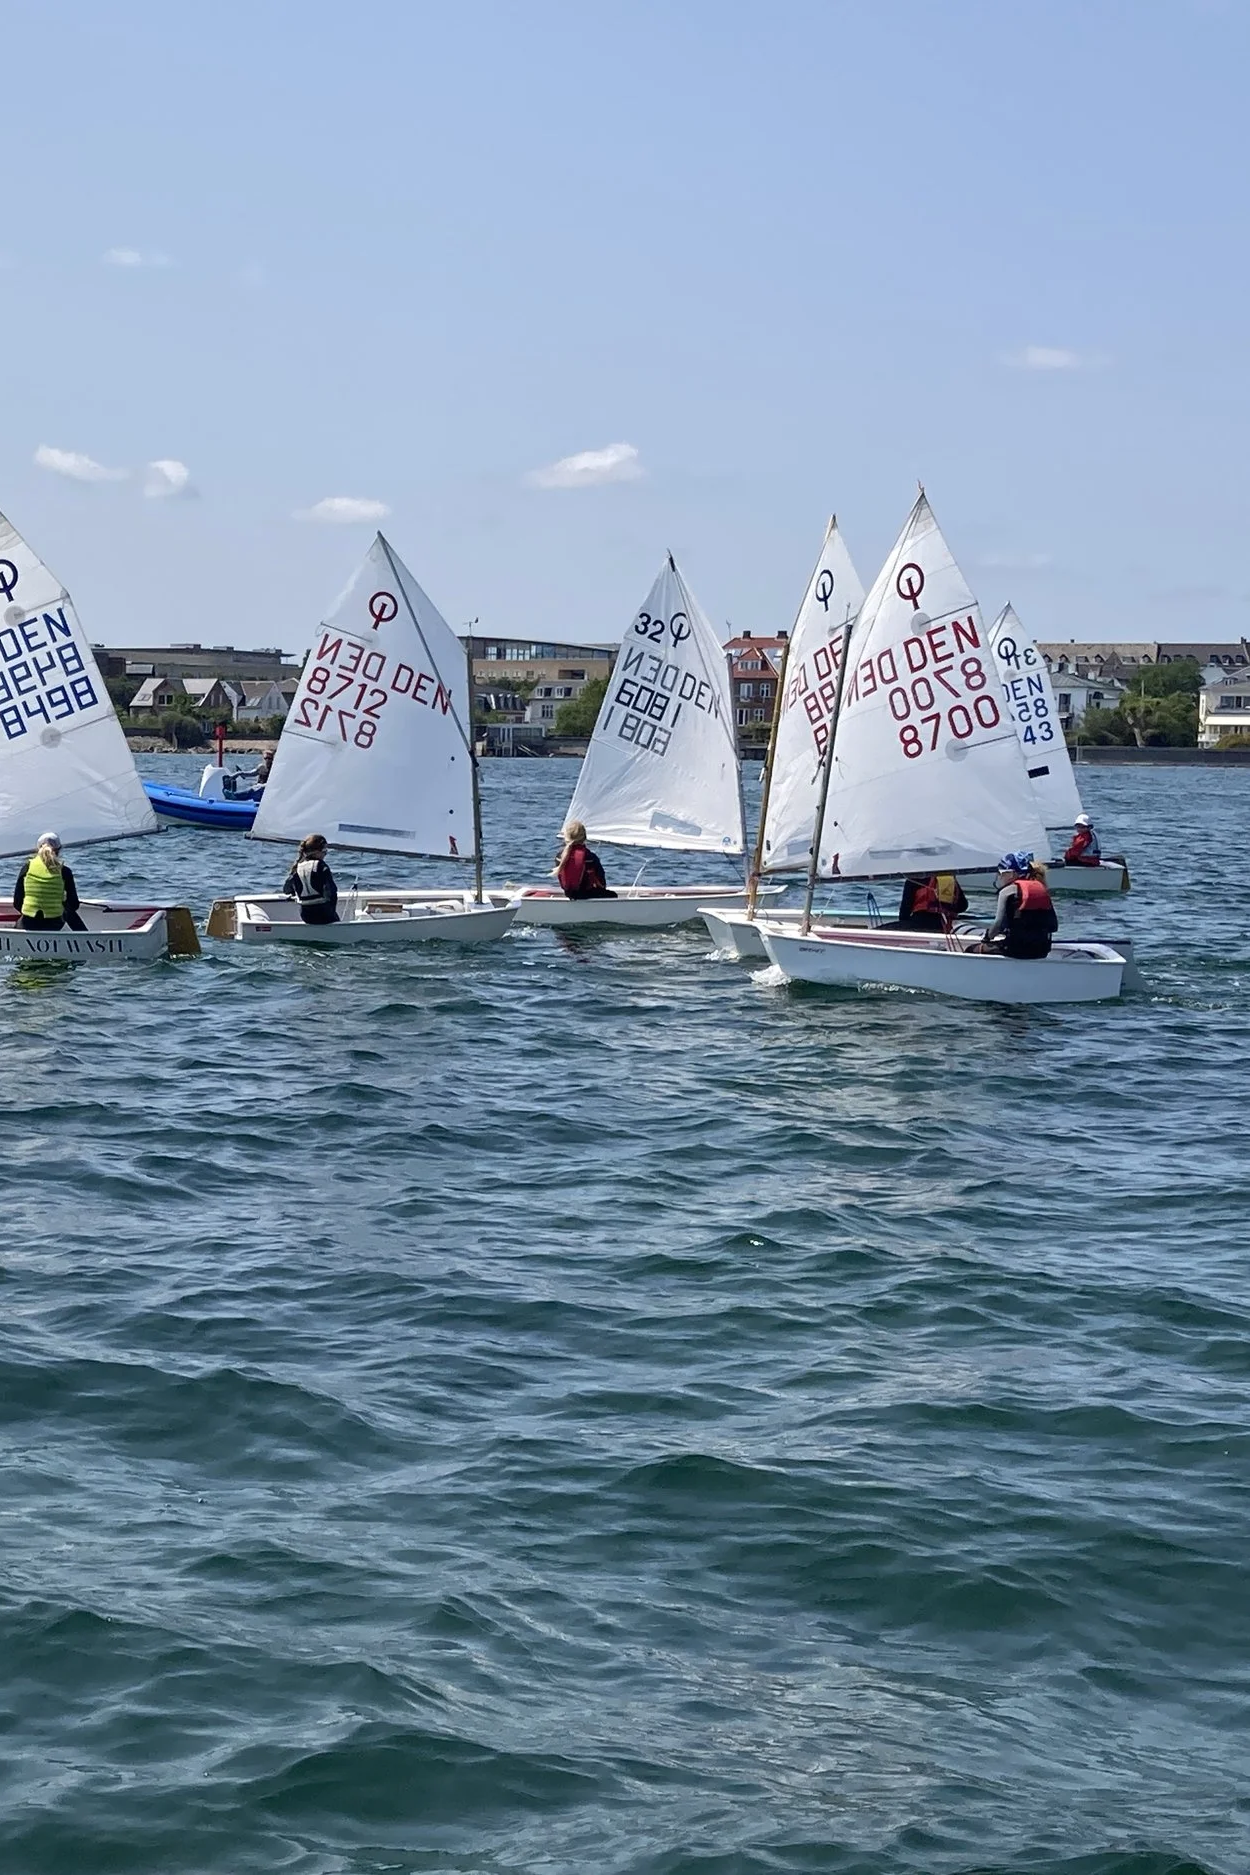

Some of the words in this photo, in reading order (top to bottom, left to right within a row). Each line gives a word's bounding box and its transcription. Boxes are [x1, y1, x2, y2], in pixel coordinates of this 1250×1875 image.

[634, 612, 661, 644] 32
[903, 615, 981, 674] DEN
[813, 635, 844, 681] DE
[307, 666, 388, 720] 8712
[391, 663, 452, 716] DEN
[614, 678, 682, 728] 6081
[678, 672, 721, 719] DEN
[899, 695, 1000, 759] 8700
[1023, 721, 1054, 745] 43
